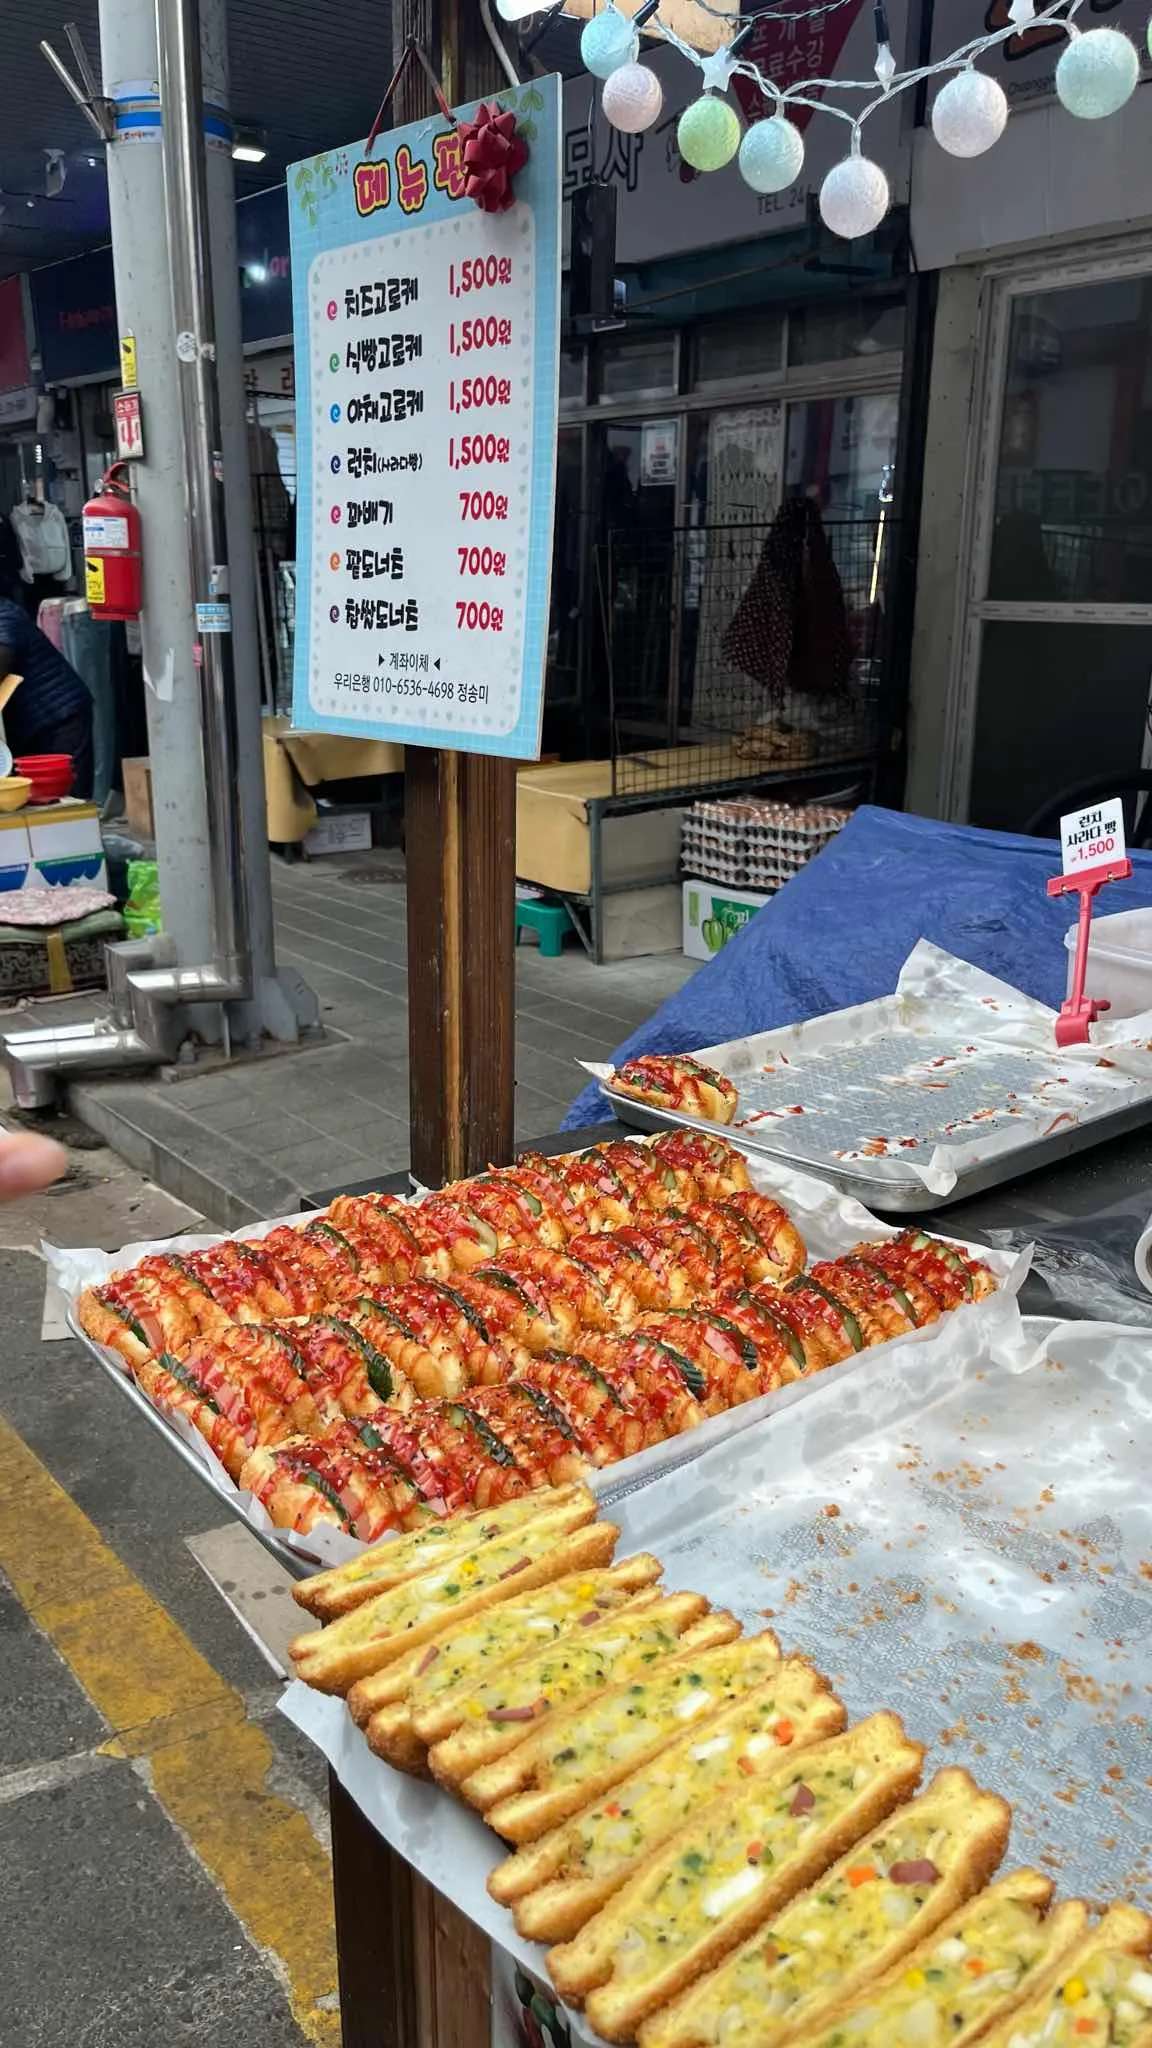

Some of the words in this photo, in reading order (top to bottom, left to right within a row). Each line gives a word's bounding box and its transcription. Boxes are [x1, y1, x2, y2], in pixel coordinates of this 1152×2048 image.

[345, 277, 419, 319] 치즈고로케
[449, 254, 512, 298] 1,500원
[346, 333, 423, 375] 식빵고로케
[449, 315, 512, 357] 1,500원
[347, 389, 424, 424] 야채고로케
[449, 375, 511, 414] 1,500원
[449, 433, 510, 470] 1,500원
[459, 490, 508, 520] 700원
[345, 547, 404, 580] 팥도너츠
[457, 546, 507, 576] 700원
[344, 598, 419, 632] 찹쌀도너츠
[456, 601, 504, 632] 700원
[389, 652, 429, 672] 계좌이체
[334, 673, 371, 694] 우리은행
[373, 677, 454, 700] 010-6536-4698
[456, 684, 489, 704] 정송미
[1066, 825, 1101, 847] 사라다
[1104, 820, 1117, 835] 빵
[1078, 810, 1102, 828] 런치
